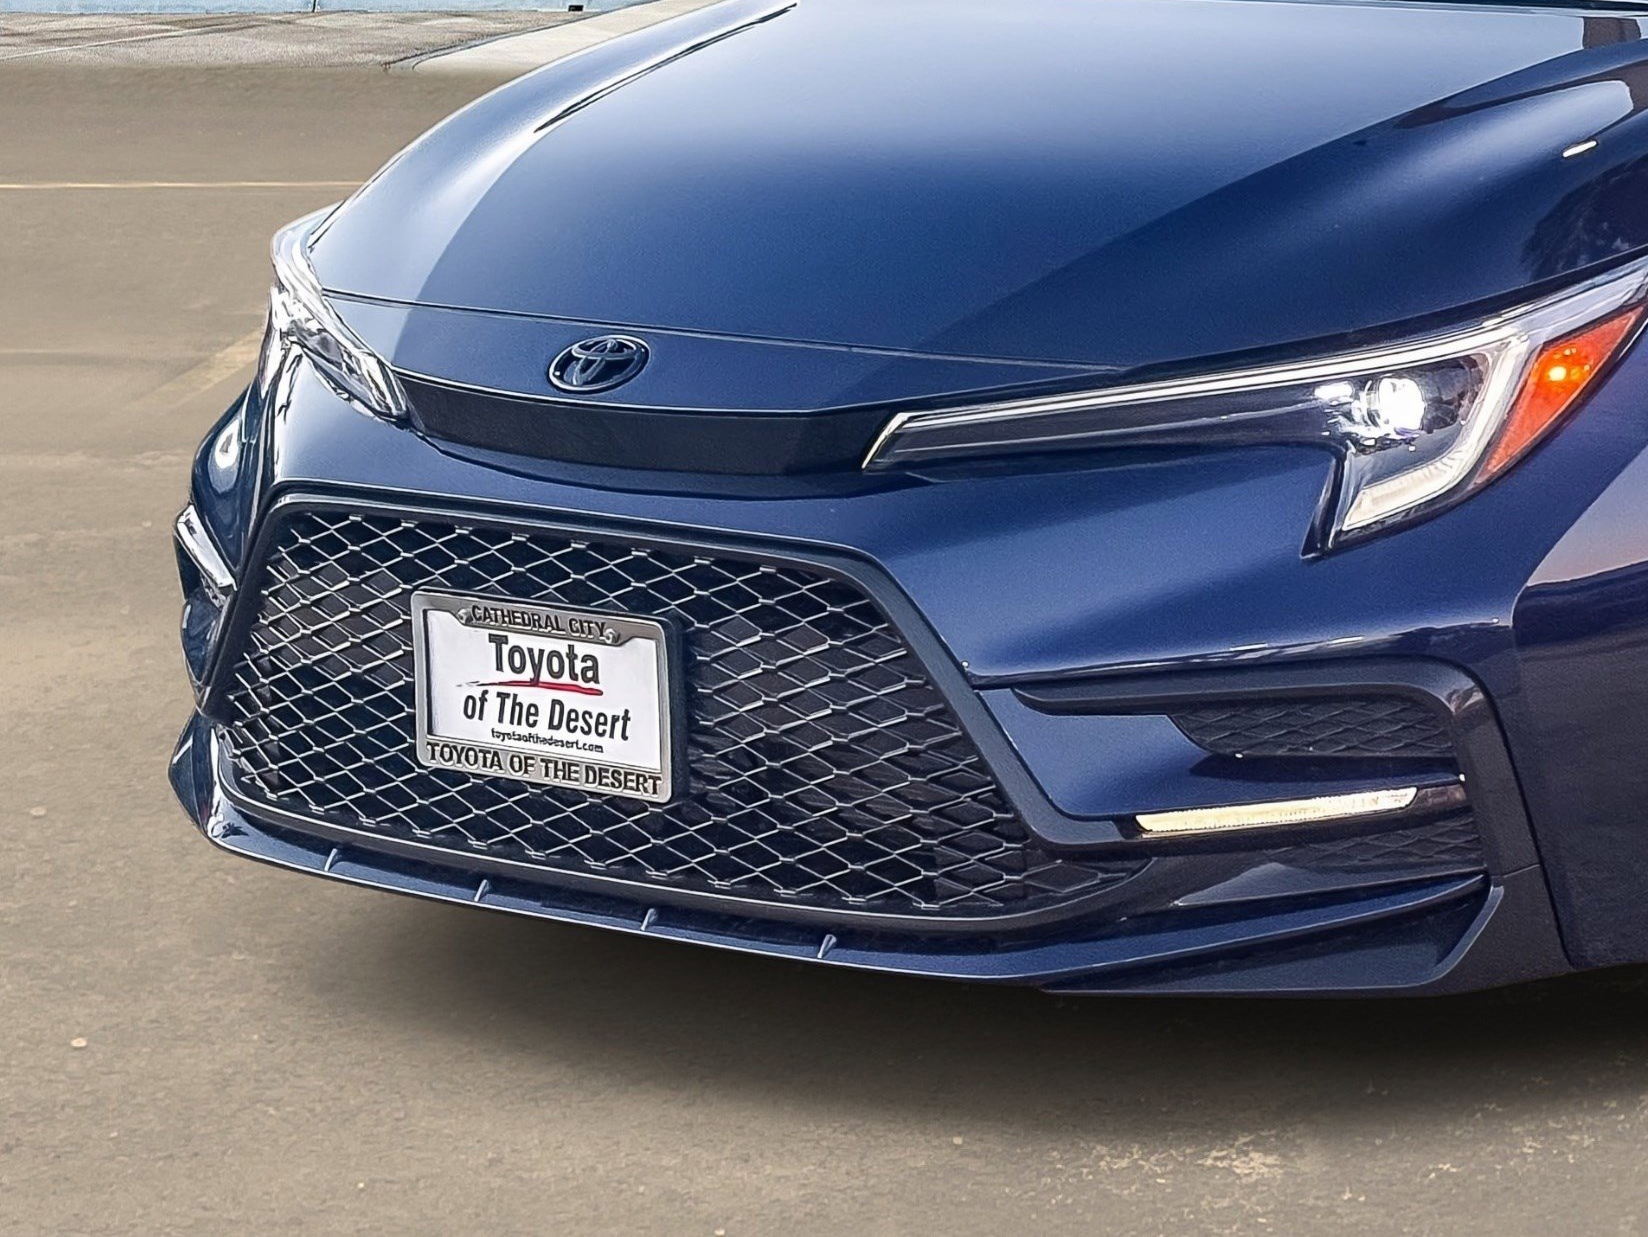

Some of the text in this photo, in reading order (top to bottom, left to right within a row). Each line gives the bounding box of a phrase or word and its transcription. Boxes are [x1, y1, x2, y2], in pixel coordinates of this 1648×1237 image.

[471, 604, 607, 639] CATHEDRAL CITY
[488, 633, 601, 686] Toyota
[463, 690, 631, 742] of The Desert
[426, 742, 662, 797] TOYOTA OF THE DESERT
